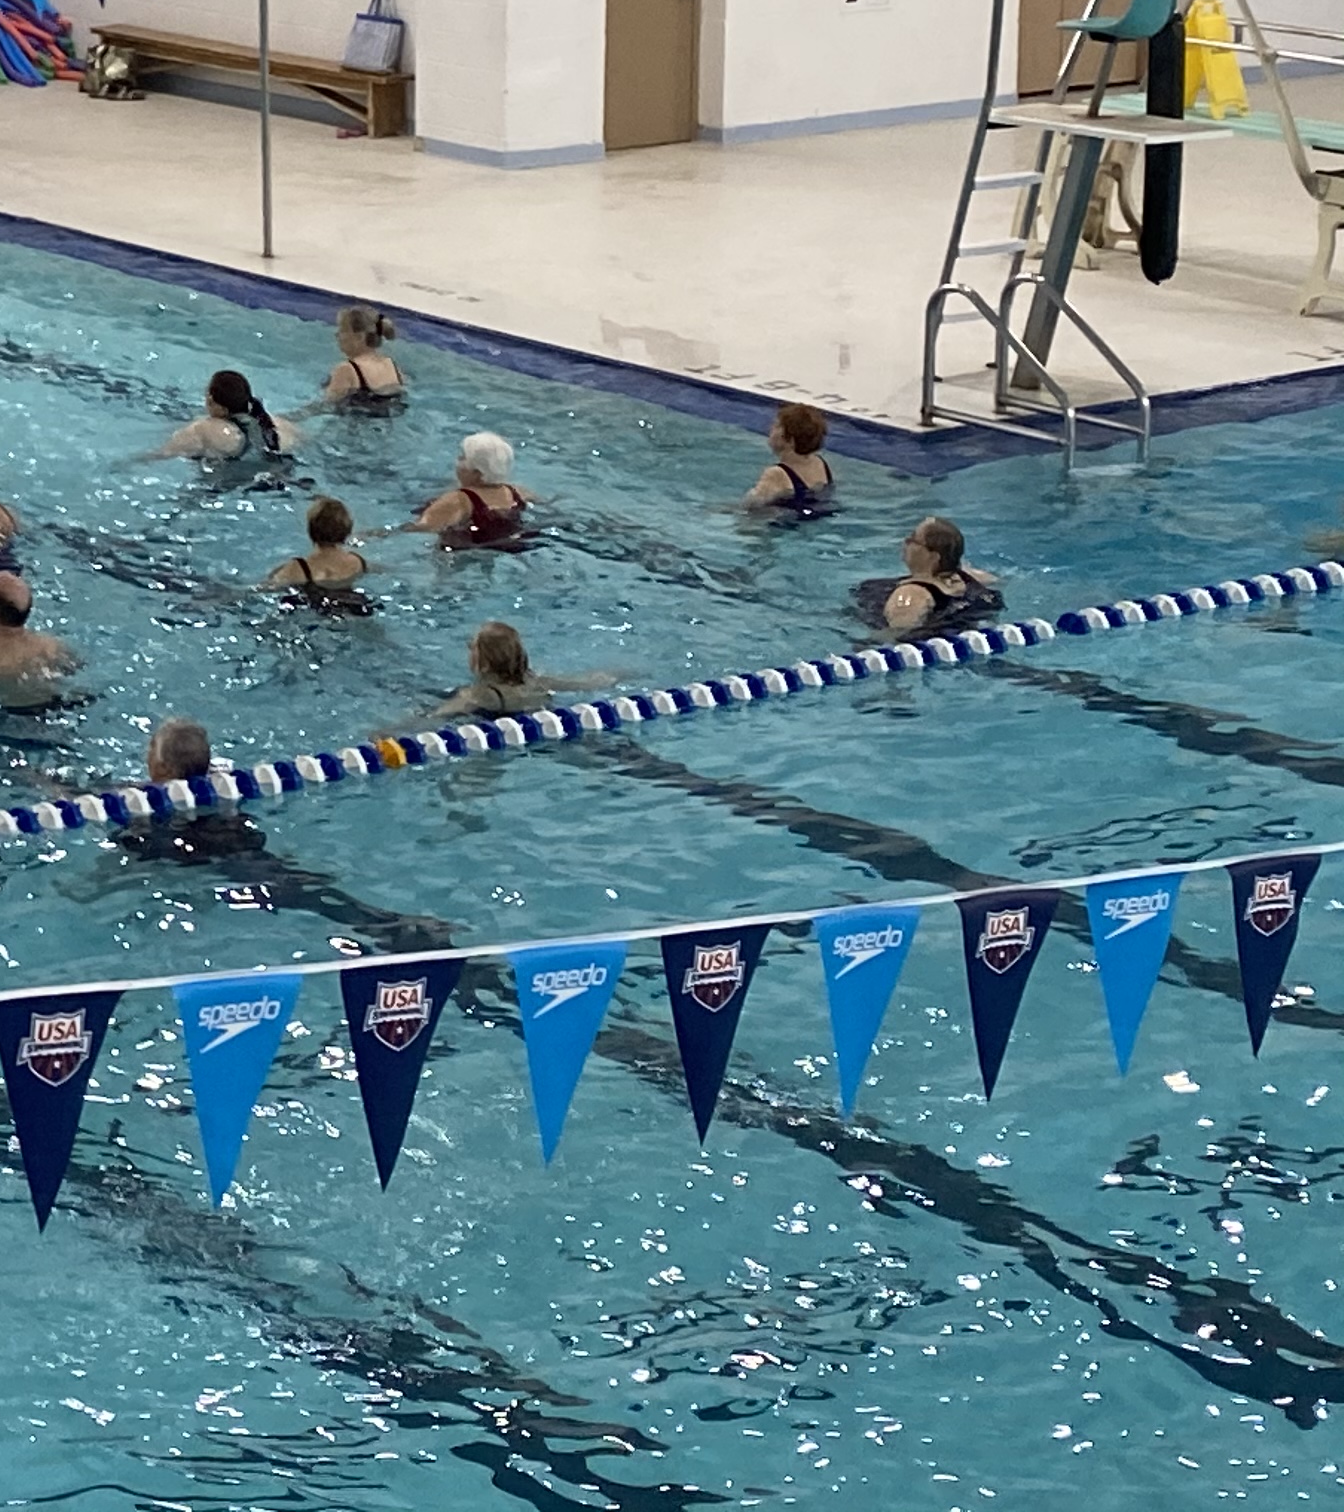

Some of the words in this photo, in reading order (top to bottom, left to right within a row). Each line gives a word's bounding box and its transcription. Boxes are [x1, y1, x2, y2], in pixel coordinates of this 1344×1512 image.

[1260, 878, 1292, 902] USA
[1102, 890, 1170, 921] speedo
[989, 916, 1022, 937] USA
[832, 925, 903, 958] speedo
[700, 949, 735, 973] USA
[531, 963, 608, 995] speedo
[383, 986, 420, 1009] USA
[199, 996, 281, 1029] speedo
[37, 1019, 78, 1042] USA
